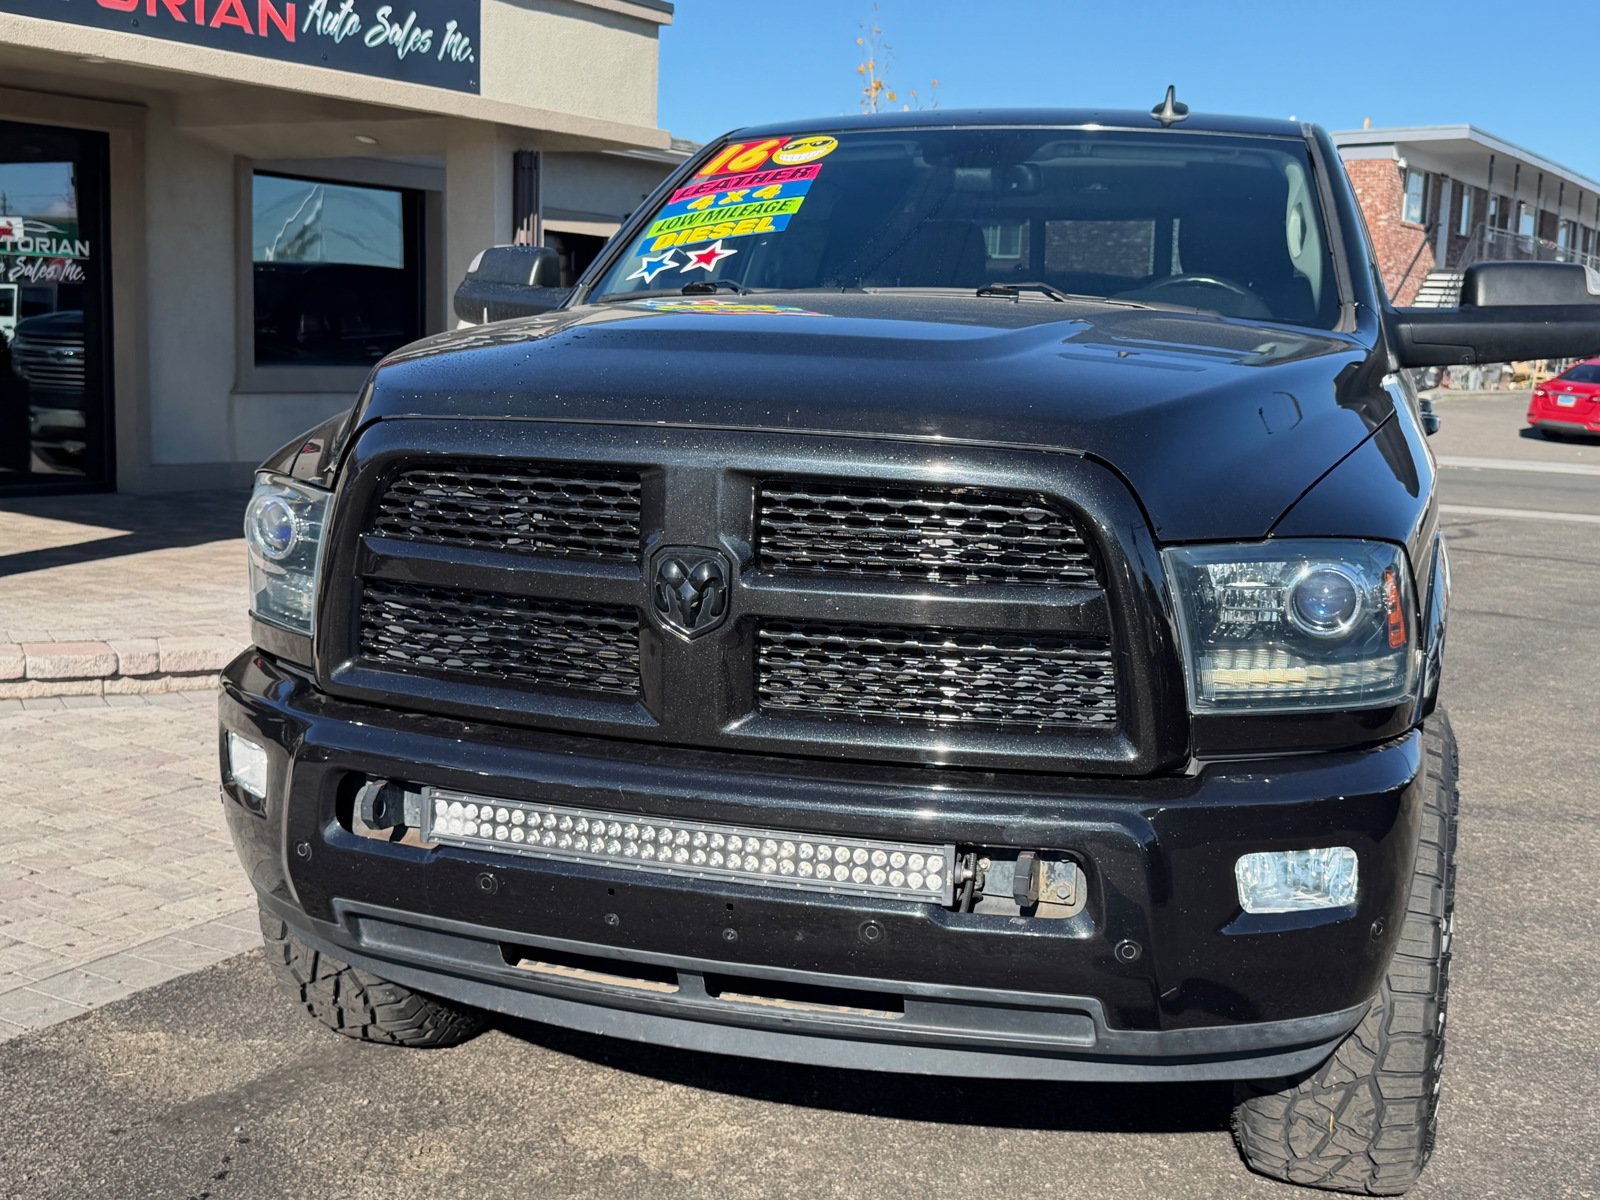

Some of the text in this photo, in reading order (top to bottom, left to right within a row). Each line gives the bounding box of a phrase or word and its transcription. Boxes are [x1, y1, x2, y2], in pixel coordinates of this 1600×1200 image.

[302, 0, 362, 44] Auto
[364, 5, 434, 60] Sales
[437, 19, 475, 63] Inc.
[700, 139, 781, 176] 16
[675, 166, 810, 201] LEATHER
[650, 217, 776, 251] DIESEL
[655, 199, 793, 234] LOW MILEAGE
